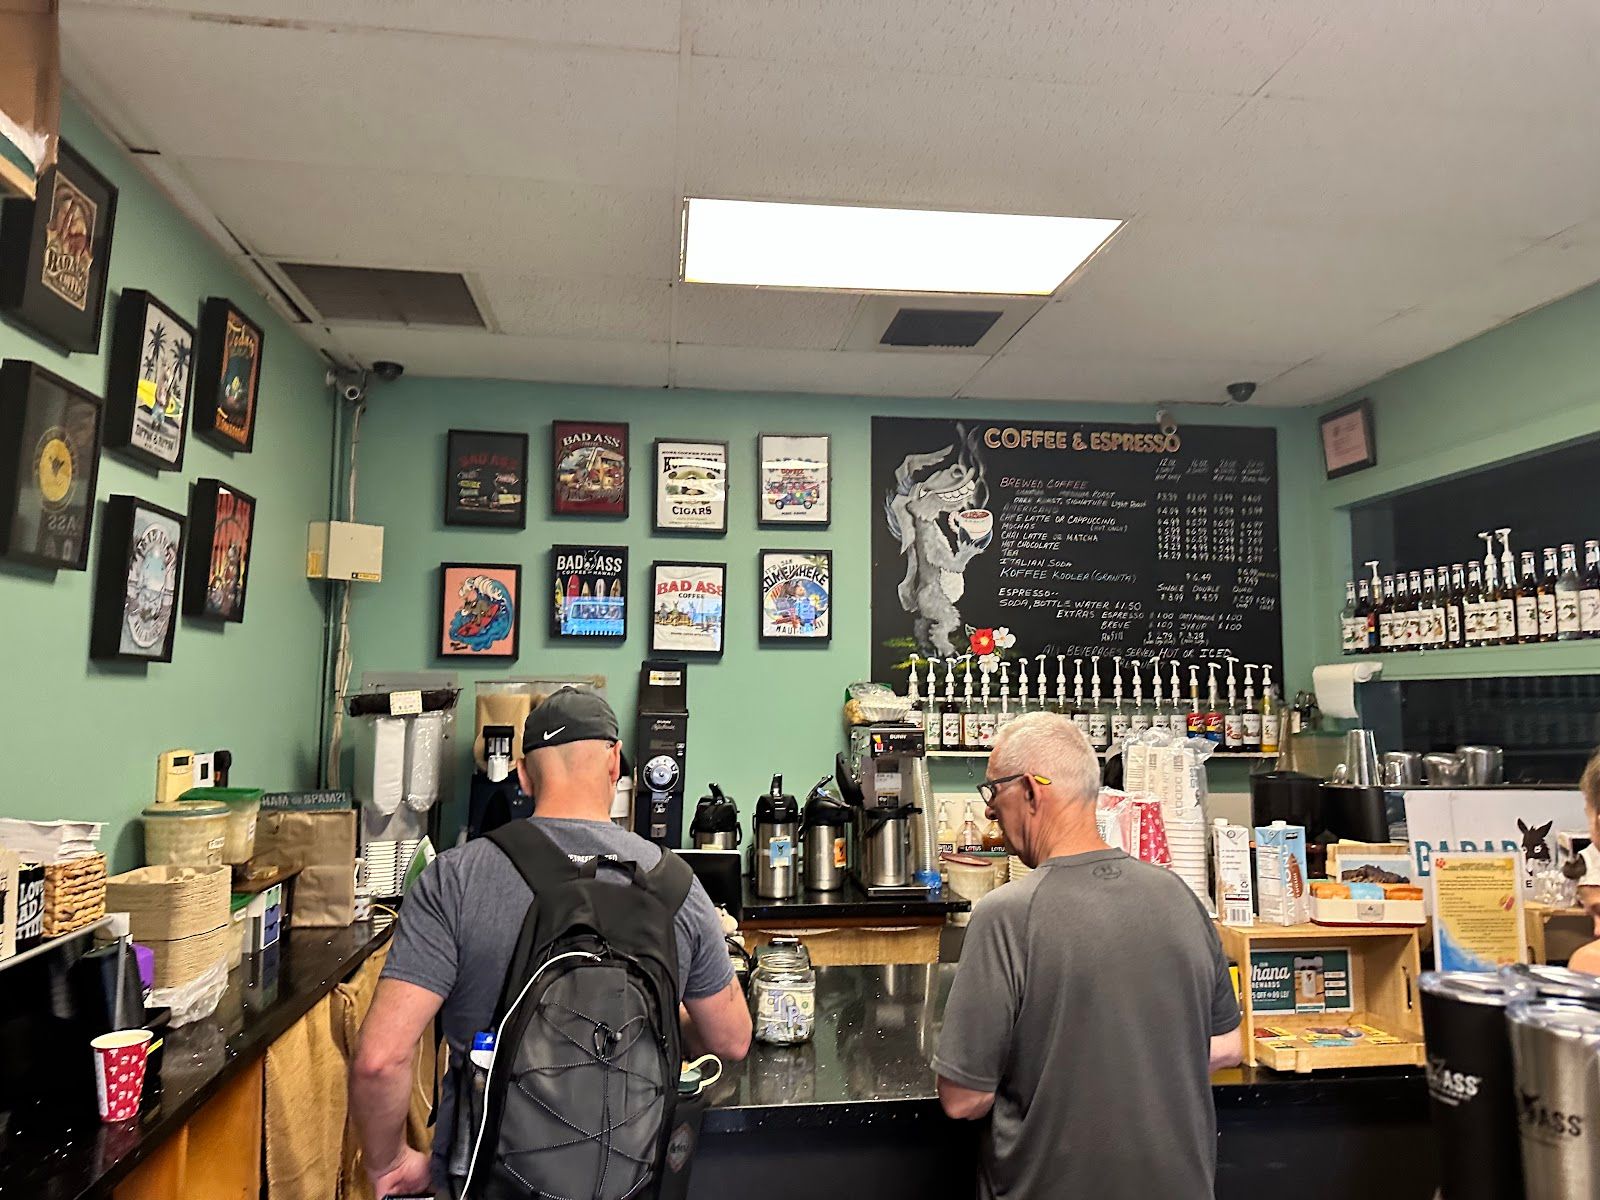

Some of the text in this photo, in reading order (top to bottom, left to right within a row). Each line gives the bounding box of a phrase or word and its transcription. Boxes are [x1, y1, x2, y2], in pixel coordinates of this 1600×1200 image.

[562, 433, 621, 448] BAD ASS
[984, 427, 1181, 454] COFFEE & ESPRESSO
[1000, 476, 1089, 490] BREWED COFFEE
[672, 505, 711, 515] CIGARS
[1000, 513, 1024, 522] CAFE
[1024, 514, 1051, 523] LATTE
[1067, 516, 1116, 526] CAPPUCCINO
[1000, 530, 1020, 540] CHAI
[1022, 532, 1048, 541] LATTE
[1066, 533, 1099, 542] MATCHA
[1000, 540, 1060, 550] HOT CHOCOLATE
[1002, 549, 1019, 557] TEA
[557, 555, 623, 573] BAD ASS
[999, 557, 1046, 567] ITALIAN
[763, 565, 829, 593] SOMEWHERE
[999, 567, 1047, 579] KOFFEE
[1052, 568, 1089, 582] KOOLER
[657, 580, 723, 596] BAD ASS
[1192, 585, 1220, 593] DOUBLE
[1033, 600, 1071, 609] BOTTLE
[1074, 601, 1109, 609] WATER
[1056, 609, 1095, 619] EXTRAS
[1101, 611, 1145, 619] ESPRESSO
[1100, 621, 1131, 630] BREVE
[1180, 622, 1207, 631] SYRUP
[1066, 645, 1122, 657] BEVERAGES
[1125, 647, 1155, 657] SERVED
[1159, 647, 1180, 658] HOT
[1200, 648, 1232, 658] ICED
[262, 796, 288, 807] HAM
[1251, 965, 1291, 981] hana
